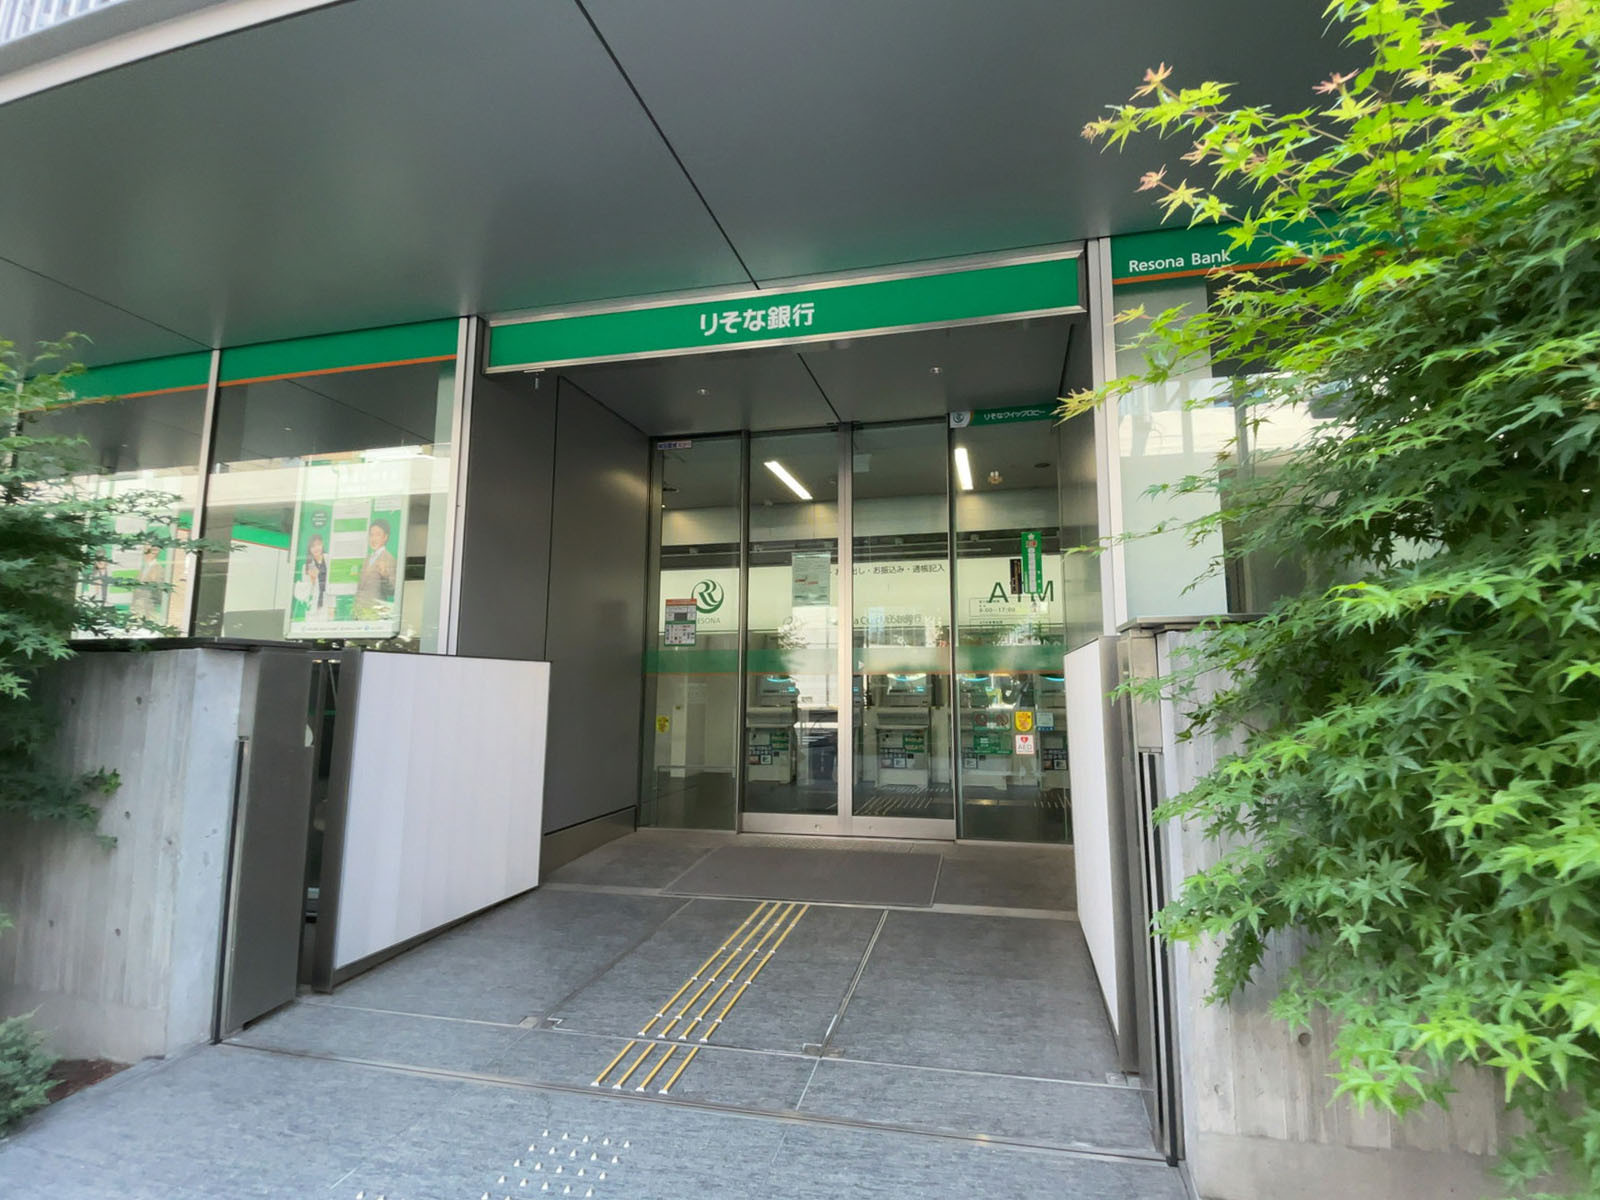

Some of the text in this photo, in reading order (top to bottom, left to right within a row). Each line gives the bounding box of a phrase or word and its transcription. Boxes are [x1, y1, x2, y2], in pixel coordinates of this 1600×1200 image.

[1128, 249, 1231, 273] Resona Bank
[700, 302, 815, 336] りそな銀行
[988, 580, 1053, 603] AM
